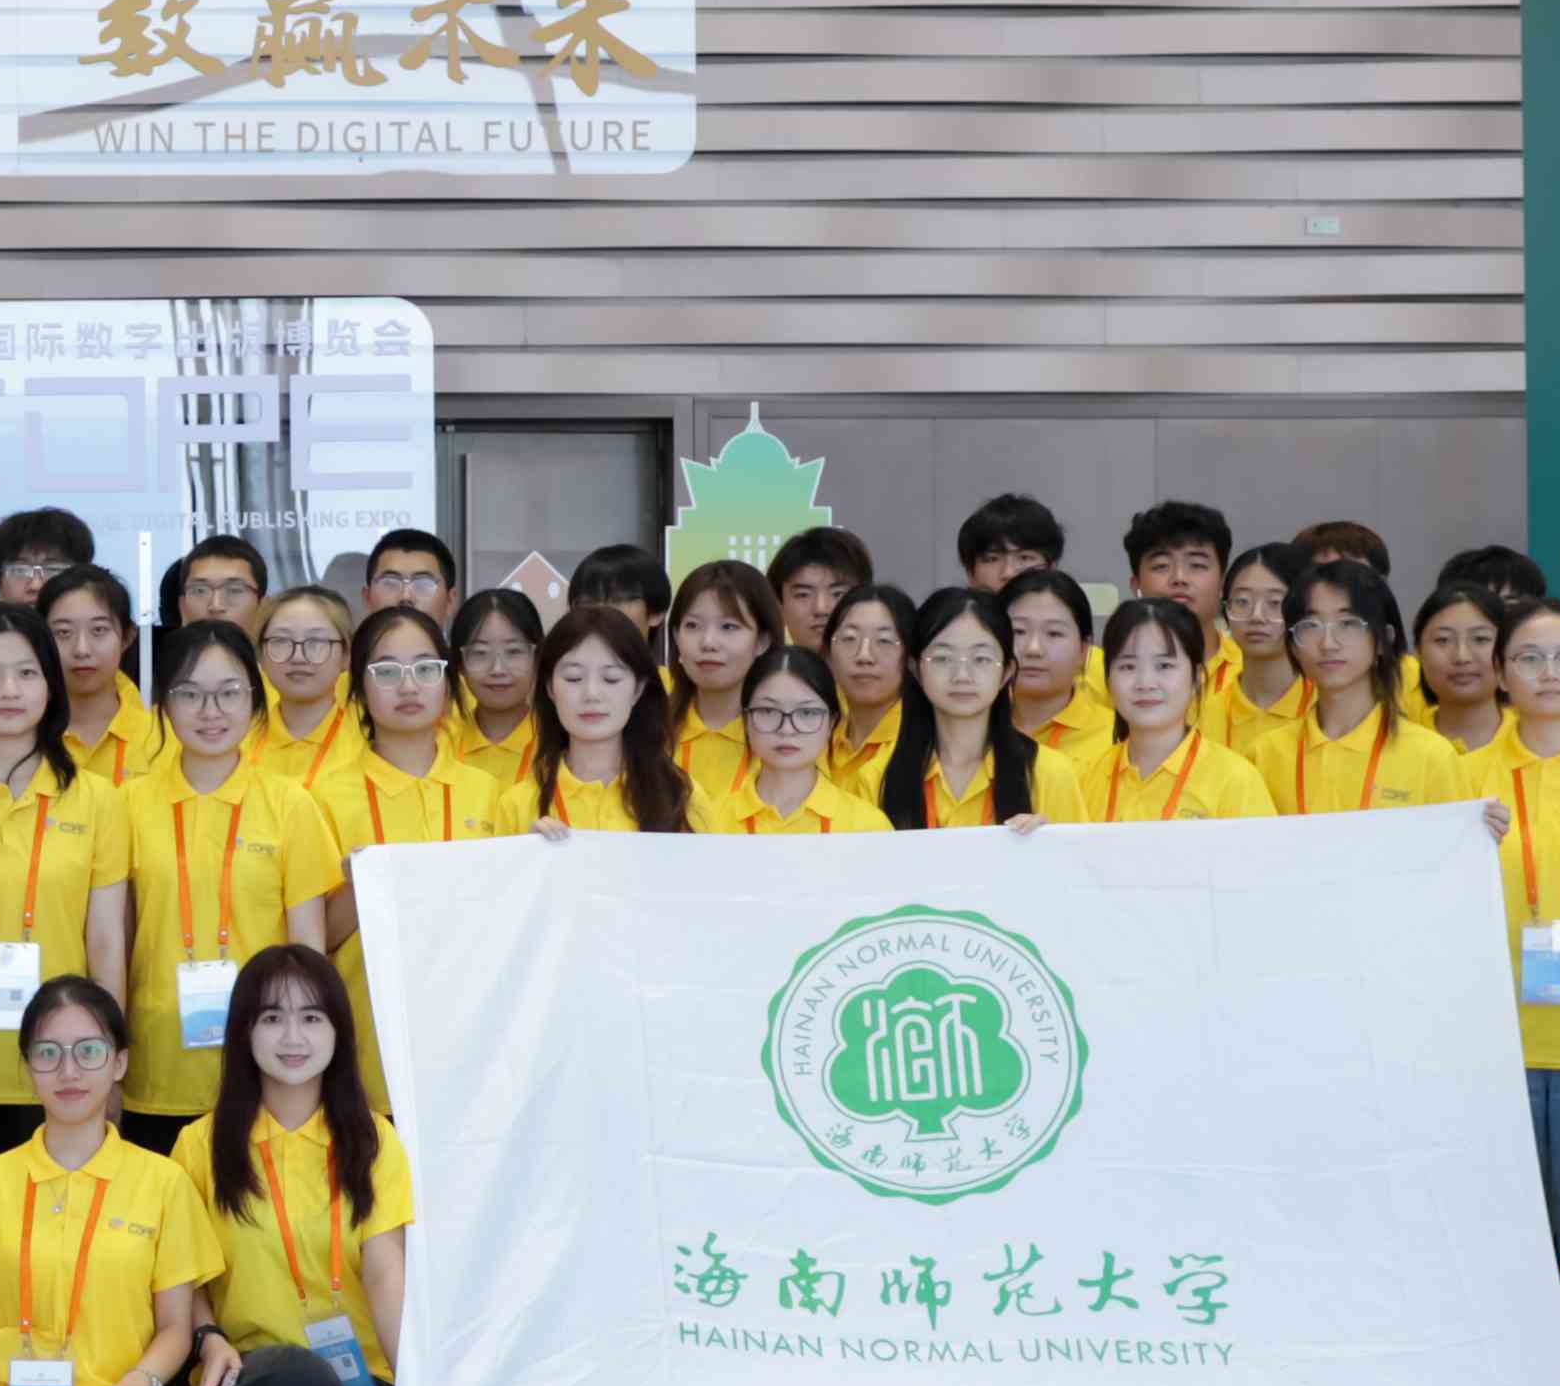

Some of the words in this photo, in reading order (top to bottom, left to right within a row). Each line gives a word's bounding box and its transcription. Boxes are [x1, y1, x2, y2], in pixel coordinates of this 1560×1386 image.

[94, 121, 176, 154] WIN
[194, 121, 276, 154] THE
[296, 119, 463, 154] DIGITAL
[483, 119, 653, 153] FUTURE
[220, 511, 351, 530] PUBLISHING
[355, 510, 411, 528] EXPO
[793, 978, 836, 1076] HAINAN
[836, 933, 951, 978] NORMAL
[962, 938, 1060, 1065] UNIVERSITY
[673, 1230, 1230, 1331] 海南师范大学
[679, 1321, 823, 1358] HAINAN
[839, 1337, 1003, 1363] NORMAL
[1018, 1336, 1234, 1366] UNIVERSITY
